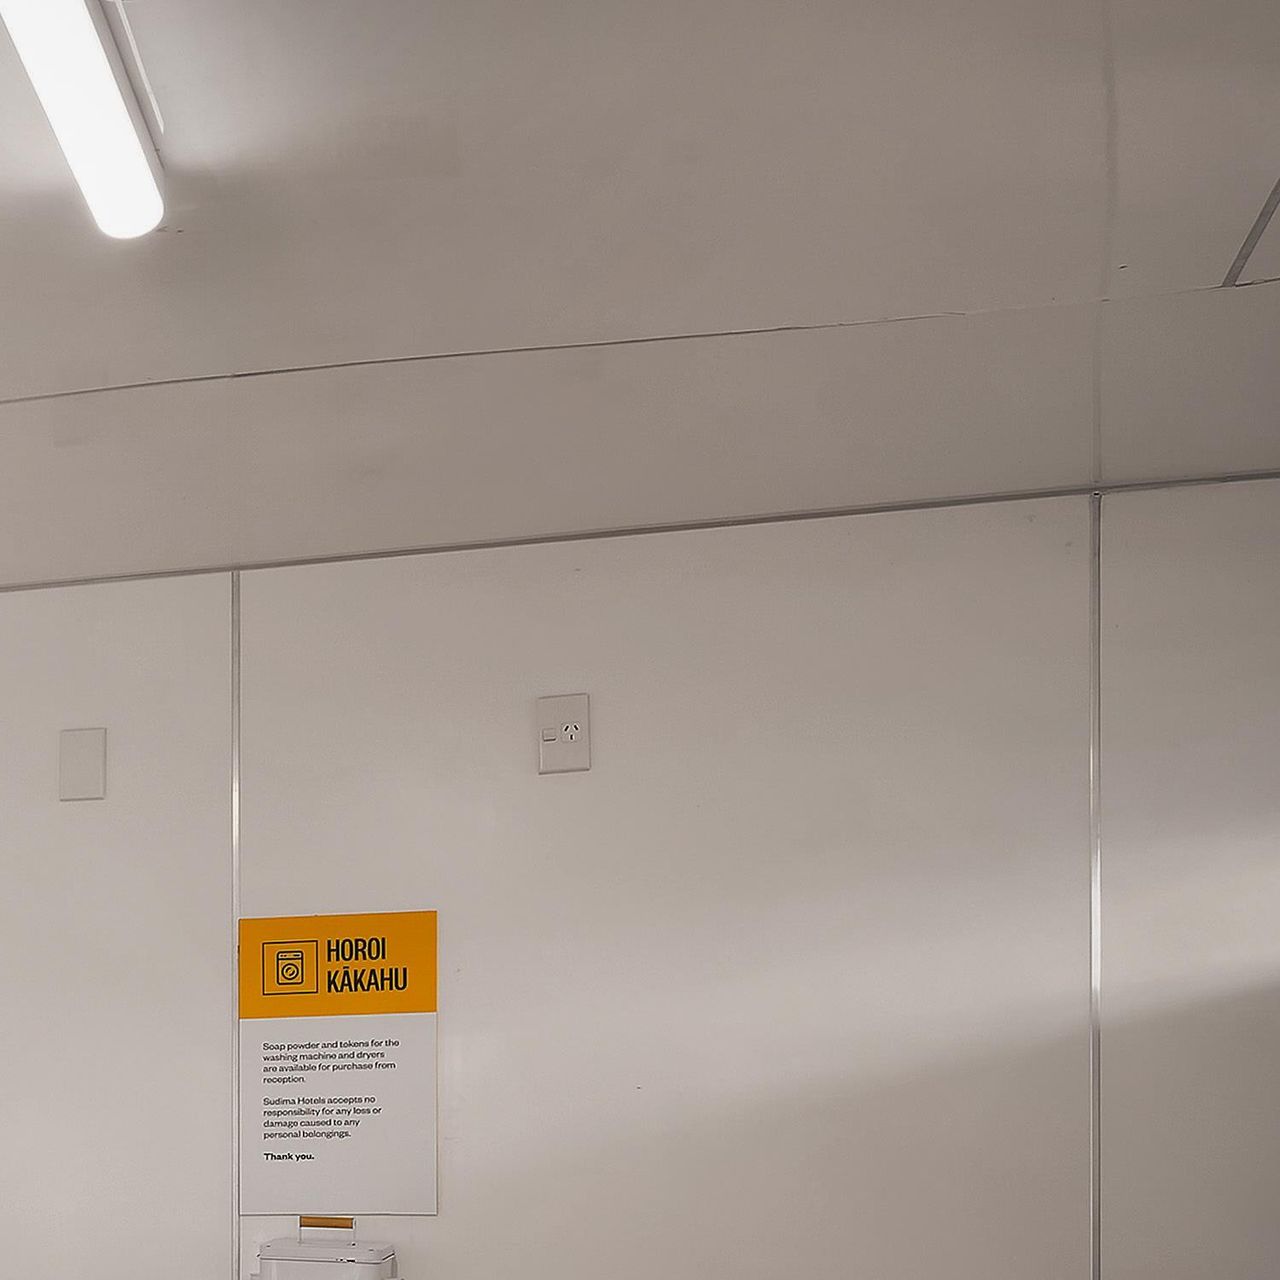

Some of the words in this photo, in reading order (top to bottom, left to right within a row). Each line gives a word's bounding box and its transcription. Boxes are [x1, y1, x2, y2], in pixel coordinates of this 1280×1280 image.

[327, 937, 386, 962] HOROI
[327, 966, 407, 993] KĀKAHU
[263, 1042, 286, 1051] Soap
[287, 1042, 320, 1051] powder
[321, 1041, 338, 1049] and
[339, 1040, 369, 1048] tokens
[371, 1039, 383, 1047] for
[385, 1038, 400, 1047] the
[263, 1053, 298, 1062] washing
[300, 1051, 337, 1060] machine
[338, 1051, 355, 1059] and
[356, 1051, 385, 1060] dryers
[279, 1064, 317, 1072] available
[318, 1063, 331, 1071] for
[332, 1062, 373, 1072] purchase
[375, 1061, 396, 1069] from
[263, 1097, 296, 1106] Sudima
[298, 1096, 326, 1105] Hotels
[327, 1097, 363, 1105] accepts
[364, 1096, 376, 1104] no
[263, 1108, 321, 1117] responsibility
[321, 1107, 334, 1115] for
[353, 1107, 371, 1115] loss
[372, 1107, 382, 1115] or
[263, 1120, 299, 1129] damage
[299, 1119, 332, 1127] caused
[344, 1119, 361, 1127] any
[263, 1130, 301, 1140] personal
[302, 1129, 352, 1140] belongings.
[263, 1152, 294, 1161] Thank
[294, 1153, 315, 1162] you.
